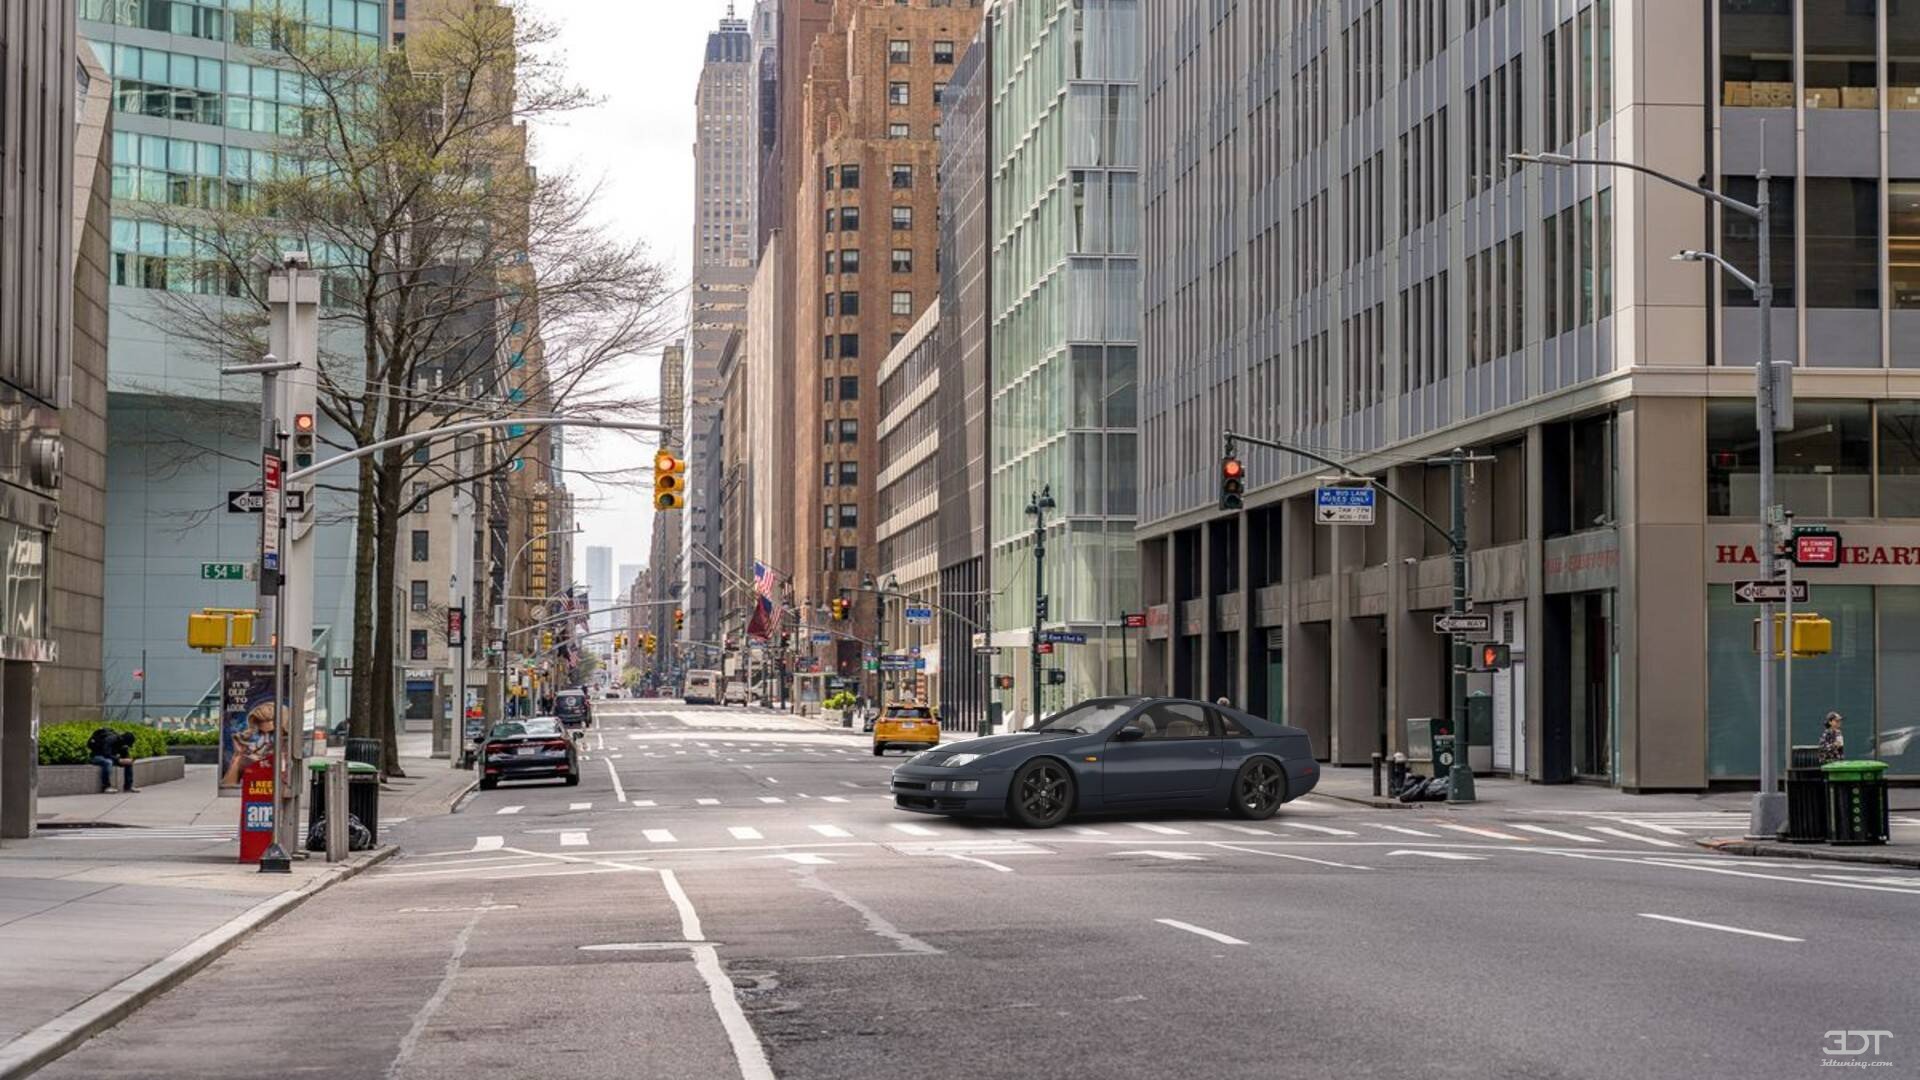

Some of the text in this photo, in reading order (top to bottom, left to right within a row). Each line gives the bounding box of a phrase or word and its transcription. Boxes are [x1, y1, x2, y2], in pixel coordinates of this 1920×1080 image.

[239, 495, 262, 507] ONE
[204, 564, 211, 578] E
[214, 564, 228, 579] 54
[1744, 586, 1767, 597] ONE
[1441, 619, 1484, 629] ONE WAY
[241, 652, 274, 660] Phone
[234, 696, 248, 704] TO
[249, 787, 273, 795] DAILY
